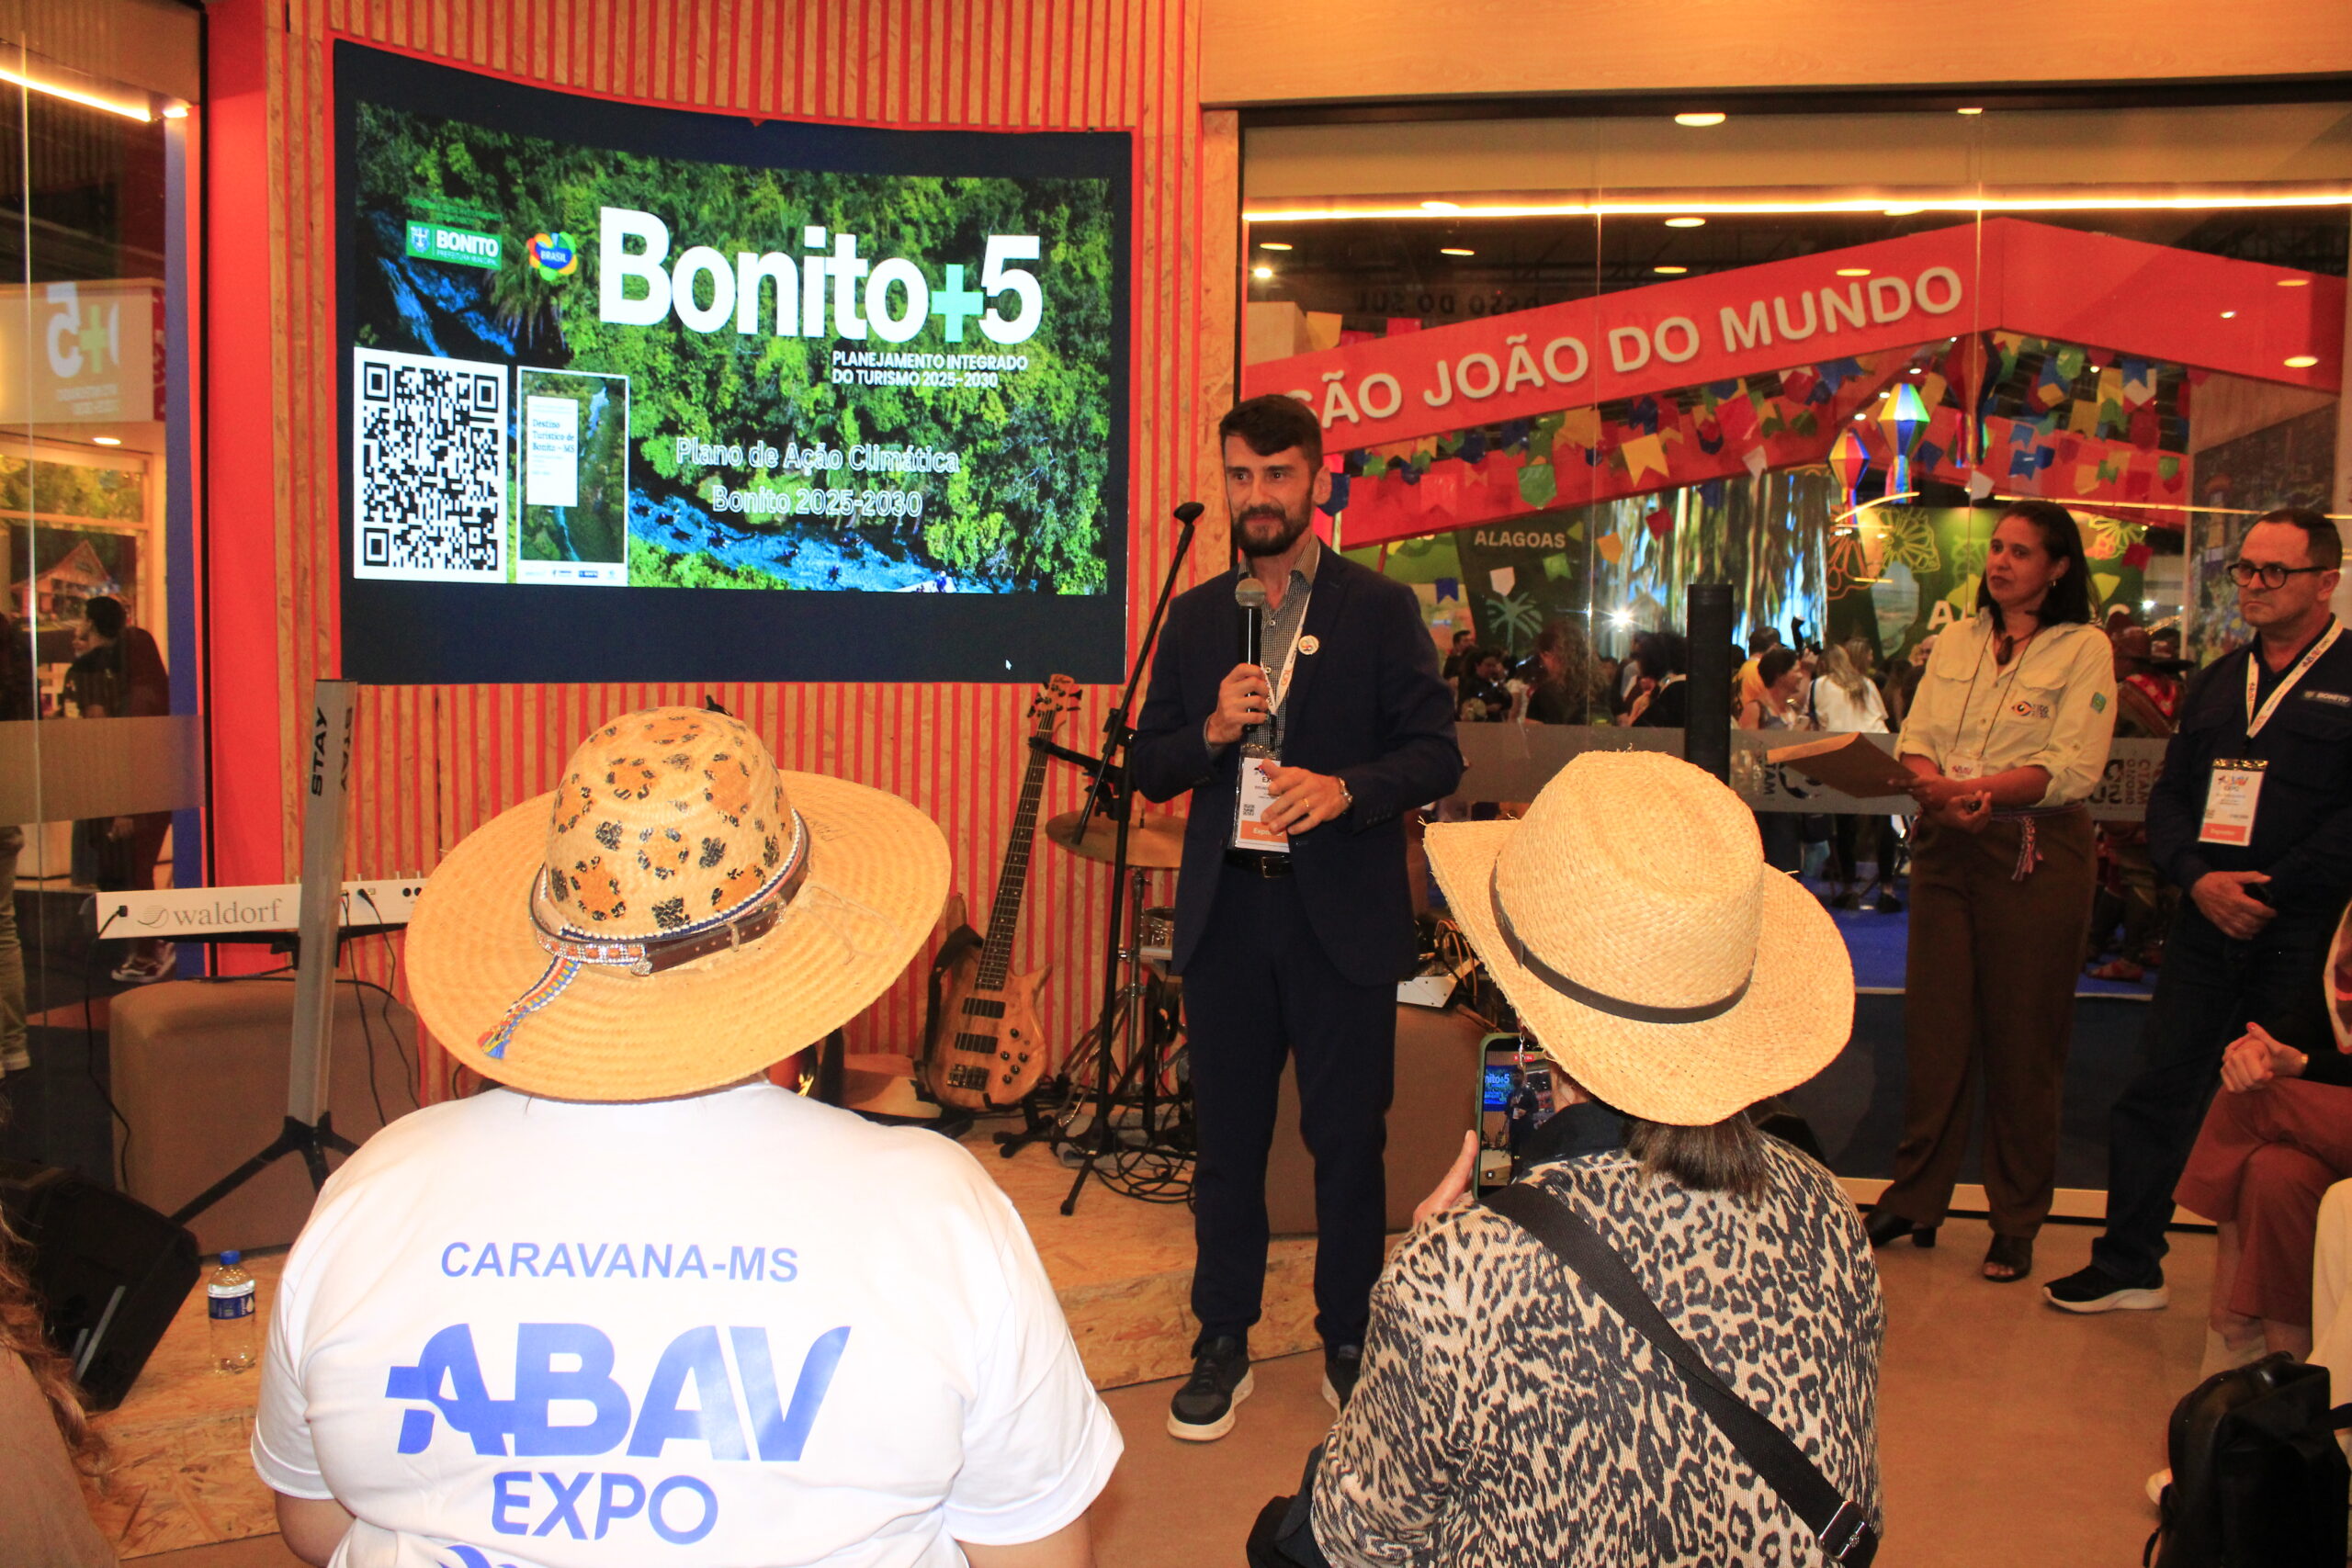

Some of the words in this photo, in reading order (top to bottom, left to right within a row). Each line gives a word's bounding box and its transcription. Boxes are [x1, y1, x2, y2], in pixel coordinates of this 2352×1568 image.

[436, 229, 499, 257] BONITO
[540, 249, 567, 264] BRASIL
[599, 206, 1043, 344] Bonito+5
[1423, 333, 1589, 407] JOÃO
[1608, 316, 1701, 373] DO
[1719, 265, 1963, 353] MUNDO
[831, 350, 945, 369] PLANEJAMENTO
[946, 355, 1029, 371] INTEGRADO
[831, 368, 854, 384] DO
[856, 369, 921, 386] TURISMO
[922, 371, 999, 388] 2025-2030
[675, 436, 743, 466] Plano
[748, 440, 779, 468] de
[783, 442, 843, 476] Ação
[848, 443, 960, 474] Climática
[712, 485, 792, 514] Bonito
[795, 488, 923, 517] 2025-2030
[1474, 530, 1566, 549] ALAGOAS
[311, 705, 328, 797] STAY
[174, 897, 283, 927] waldorf
[441, 1242, 799, 1283] CARAVANA-MS
[385, 1322, 853, 1462] ABAV
[492, 1471, 719, 1546] EXPO
